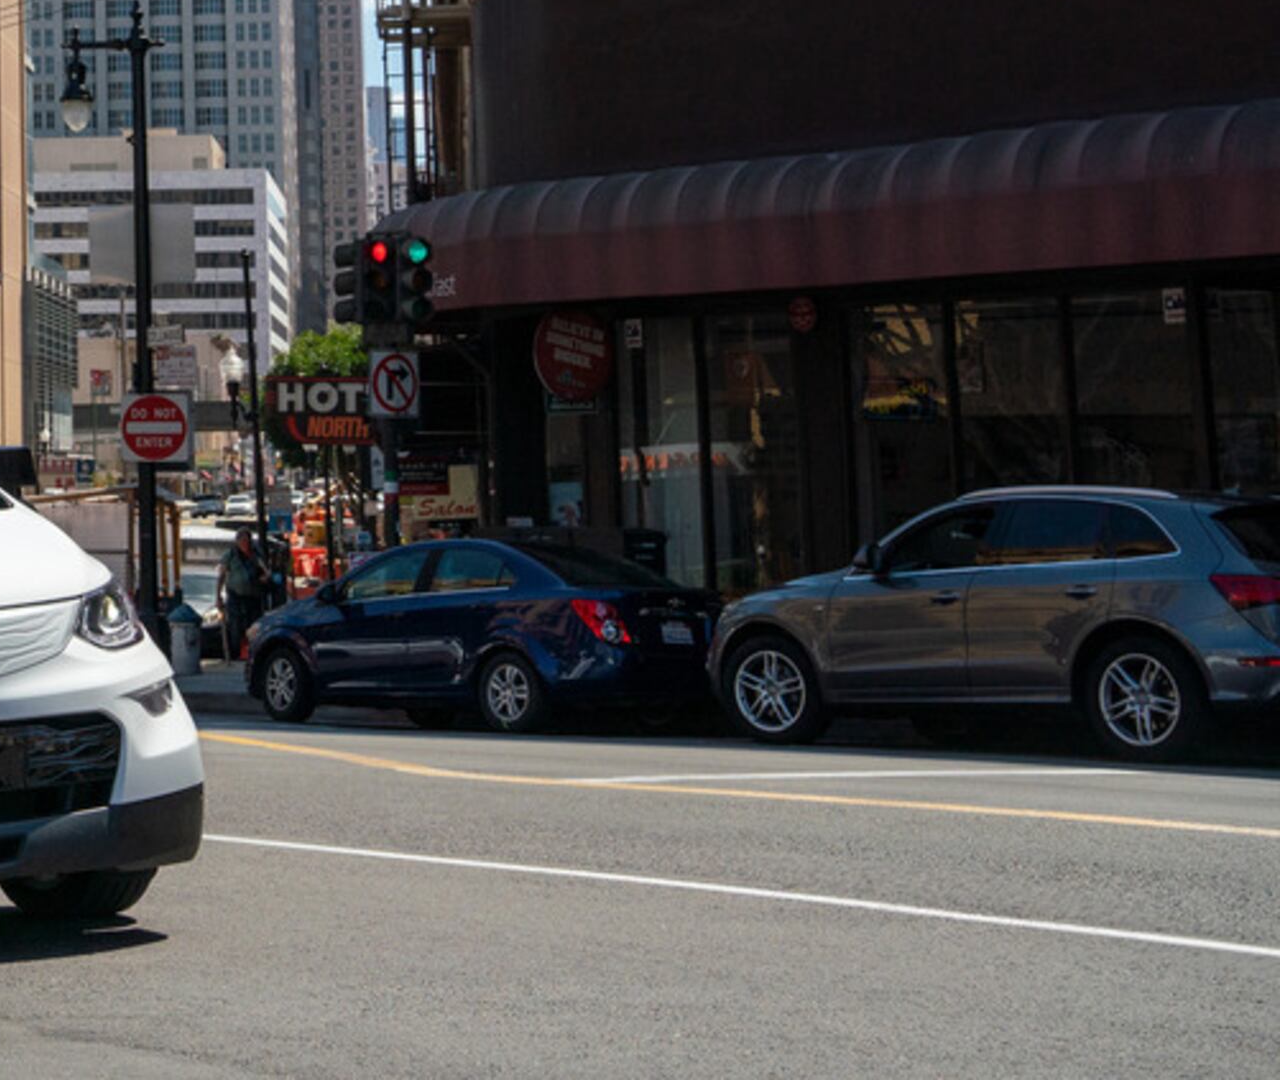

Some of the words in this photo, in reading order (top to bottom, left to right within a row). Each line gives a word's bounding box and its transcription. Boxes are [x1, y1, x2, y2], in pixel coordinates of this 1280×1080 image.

[277, 382, 370, 412] HOT
[130, 407, 148, 419] DO
[153, 407, 176, 419] NOT
[135, 435, 173, 448] ENTER
[417, 498, 477, 518] Salon
